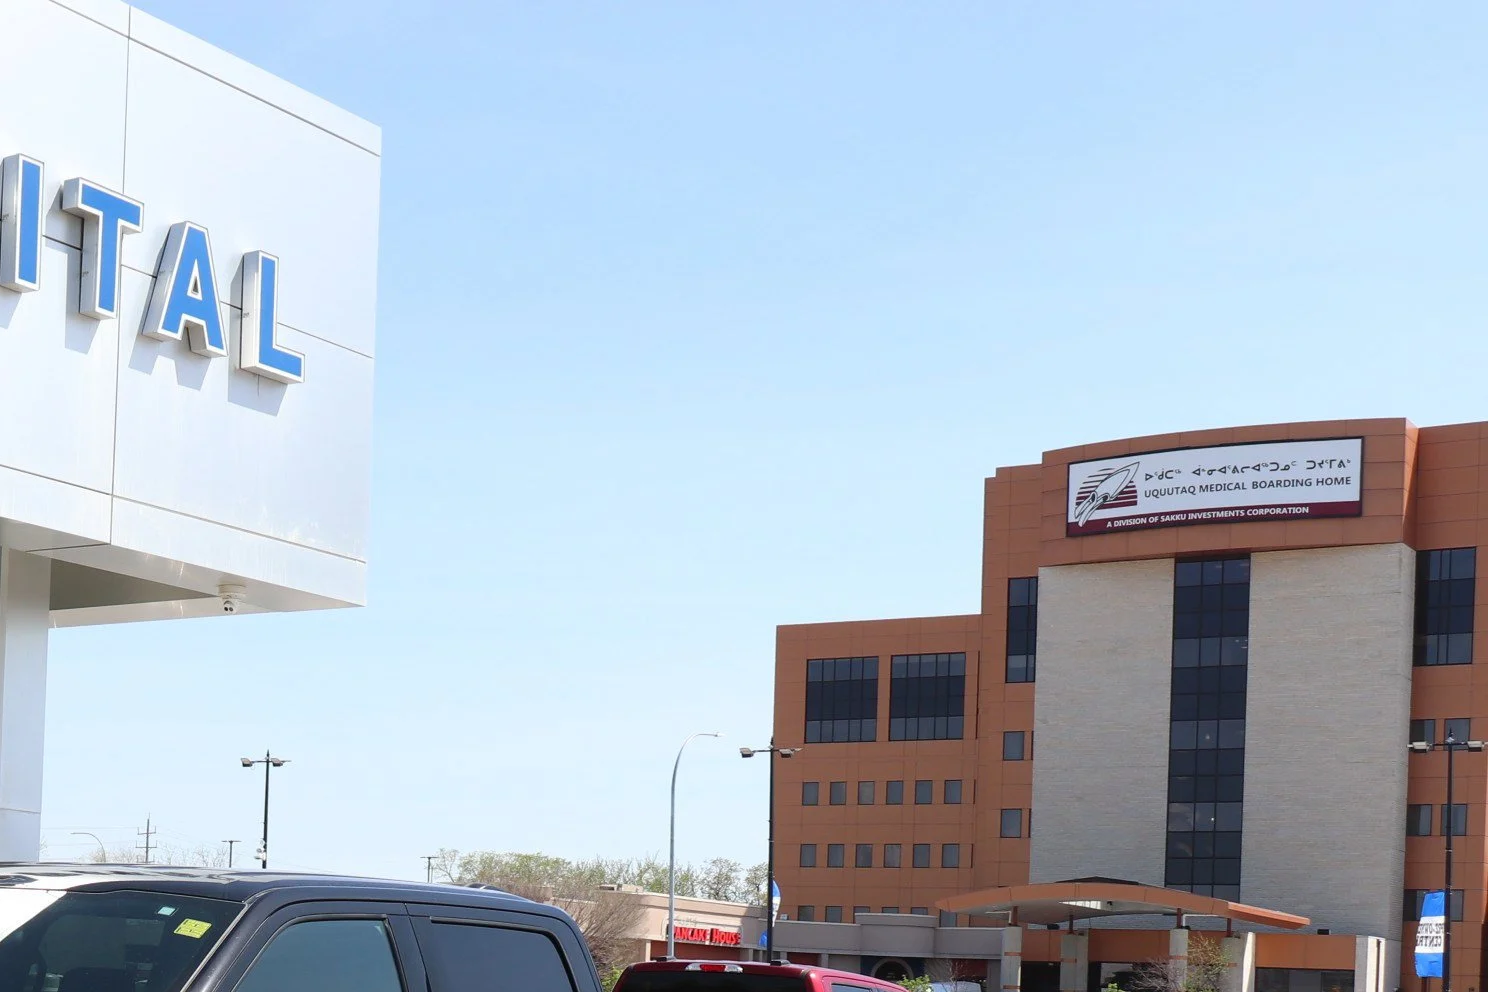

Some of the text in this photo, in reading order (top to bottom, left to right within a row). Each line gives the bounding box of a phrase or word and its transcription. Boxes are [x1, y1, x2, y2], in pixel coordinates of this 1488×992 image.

[1144, 476, 1352, 498] UQUUTAQ MEDICAL BOARDING HOME
[1113, 517, 1147, 527] DIVISION
[1148, 516, 1159, 524] OF
[1160, 513, 1187, 522] SAKKU
[1188, 510, 1245, 520] INVESTMENTS
[1246, 506, 1310, 516] CORPORATION
[674, 926, 710, 943] ANCAKE
